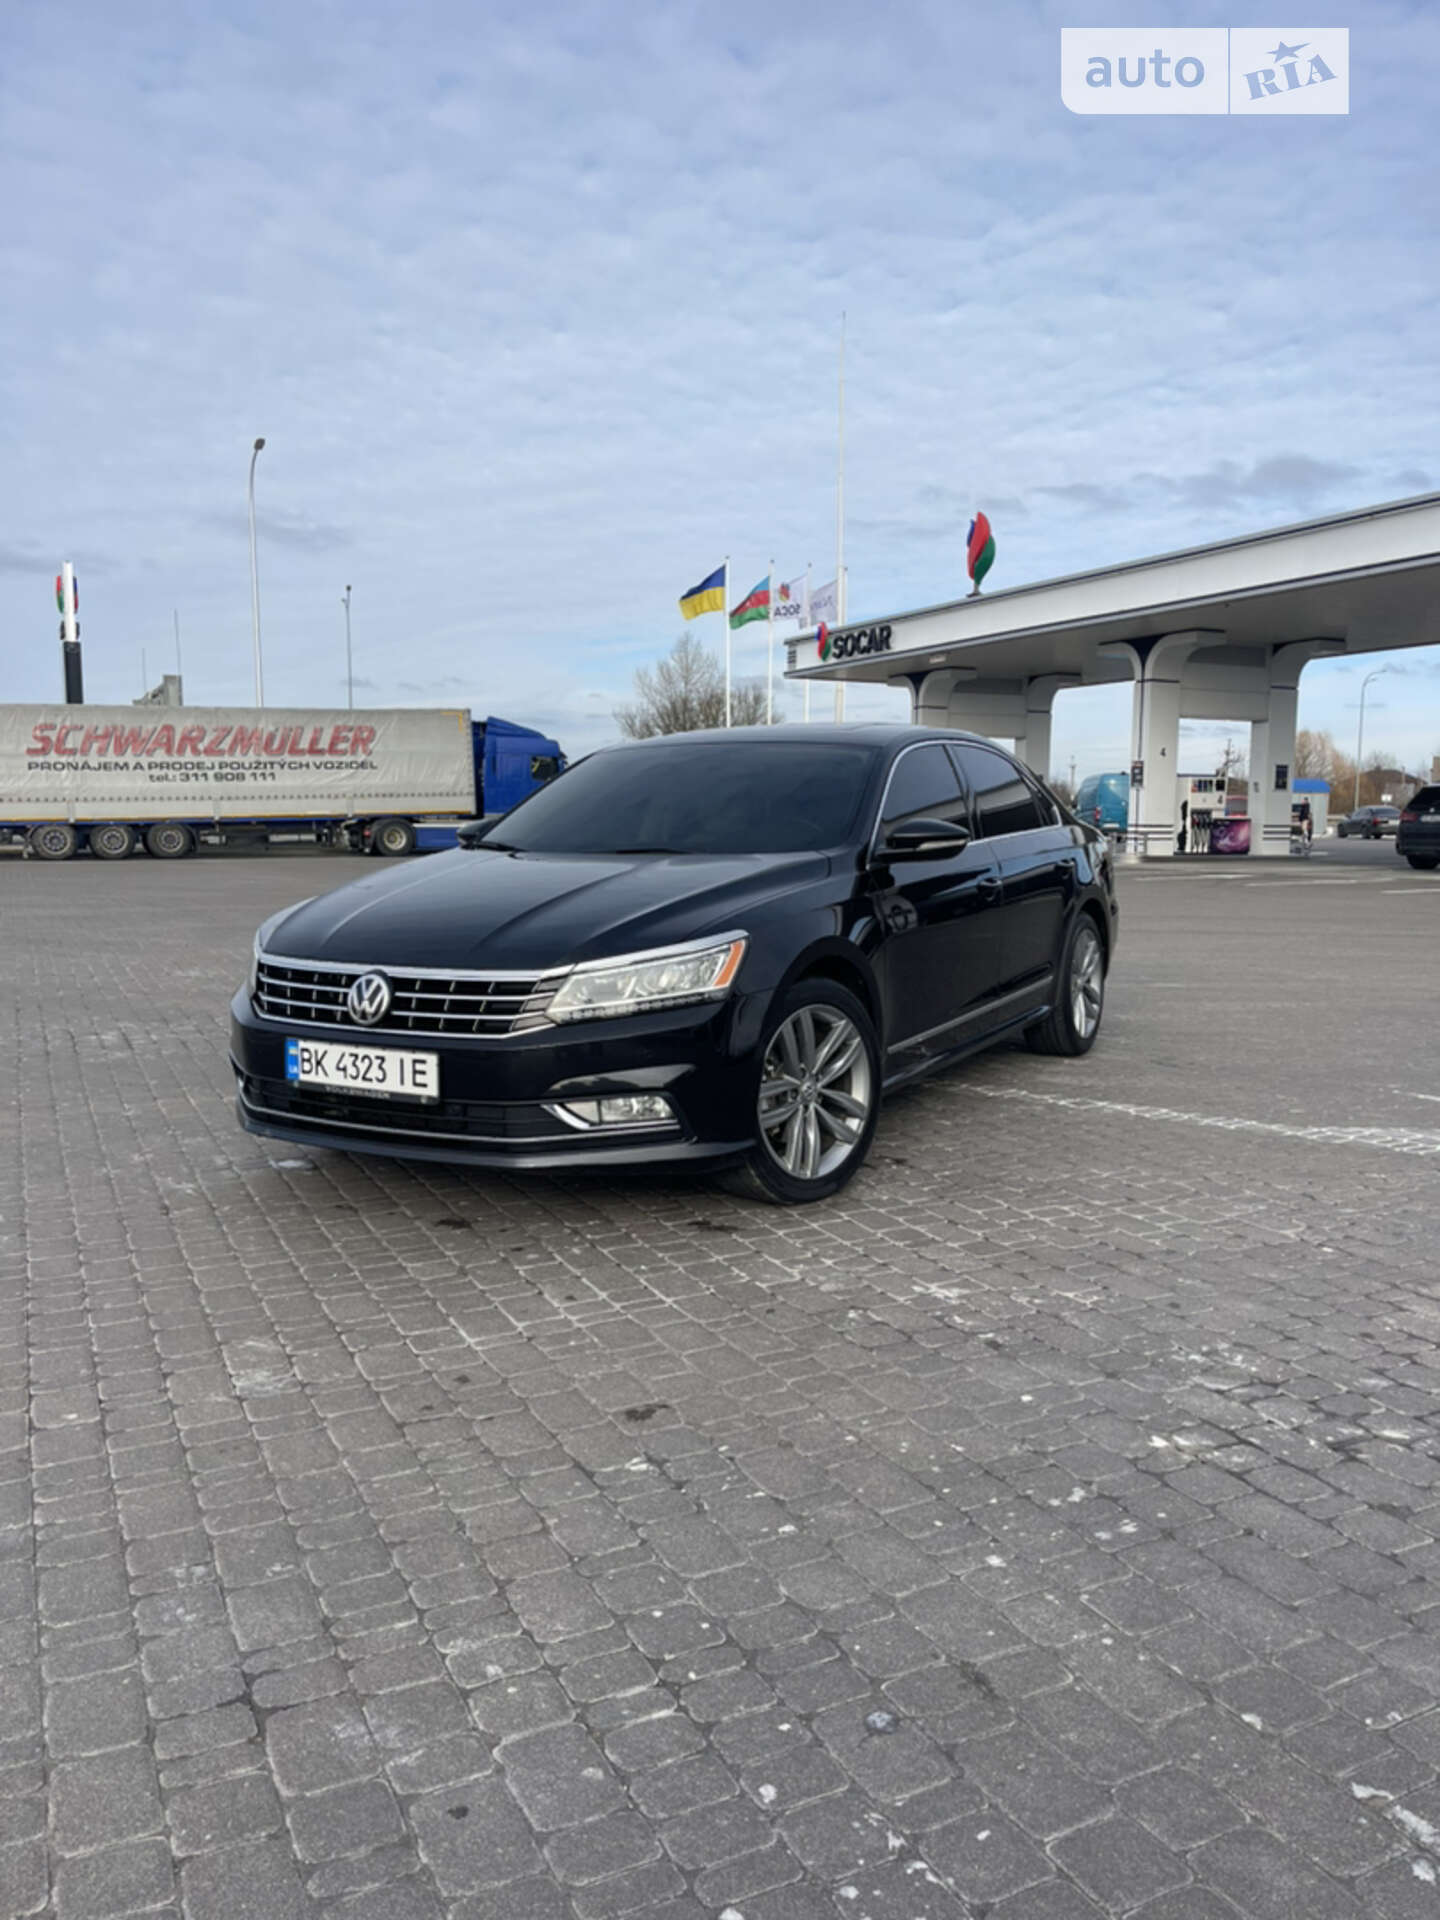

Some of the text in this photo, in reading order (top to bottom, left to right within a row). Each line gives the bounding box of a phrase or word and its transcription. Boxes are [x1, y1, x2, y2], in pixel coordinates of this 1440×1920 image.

[831, 625, 892, 660] SOCAR
[132, 761, 145, 771] A
[147, 761, 215, 771] PRODEJ
[179, 772, 208, 782] 311
[250, 772, 276, 781] 111
[300, 1048, 329, 1077] BK
[336, 1052, 388, 1084] 4323
